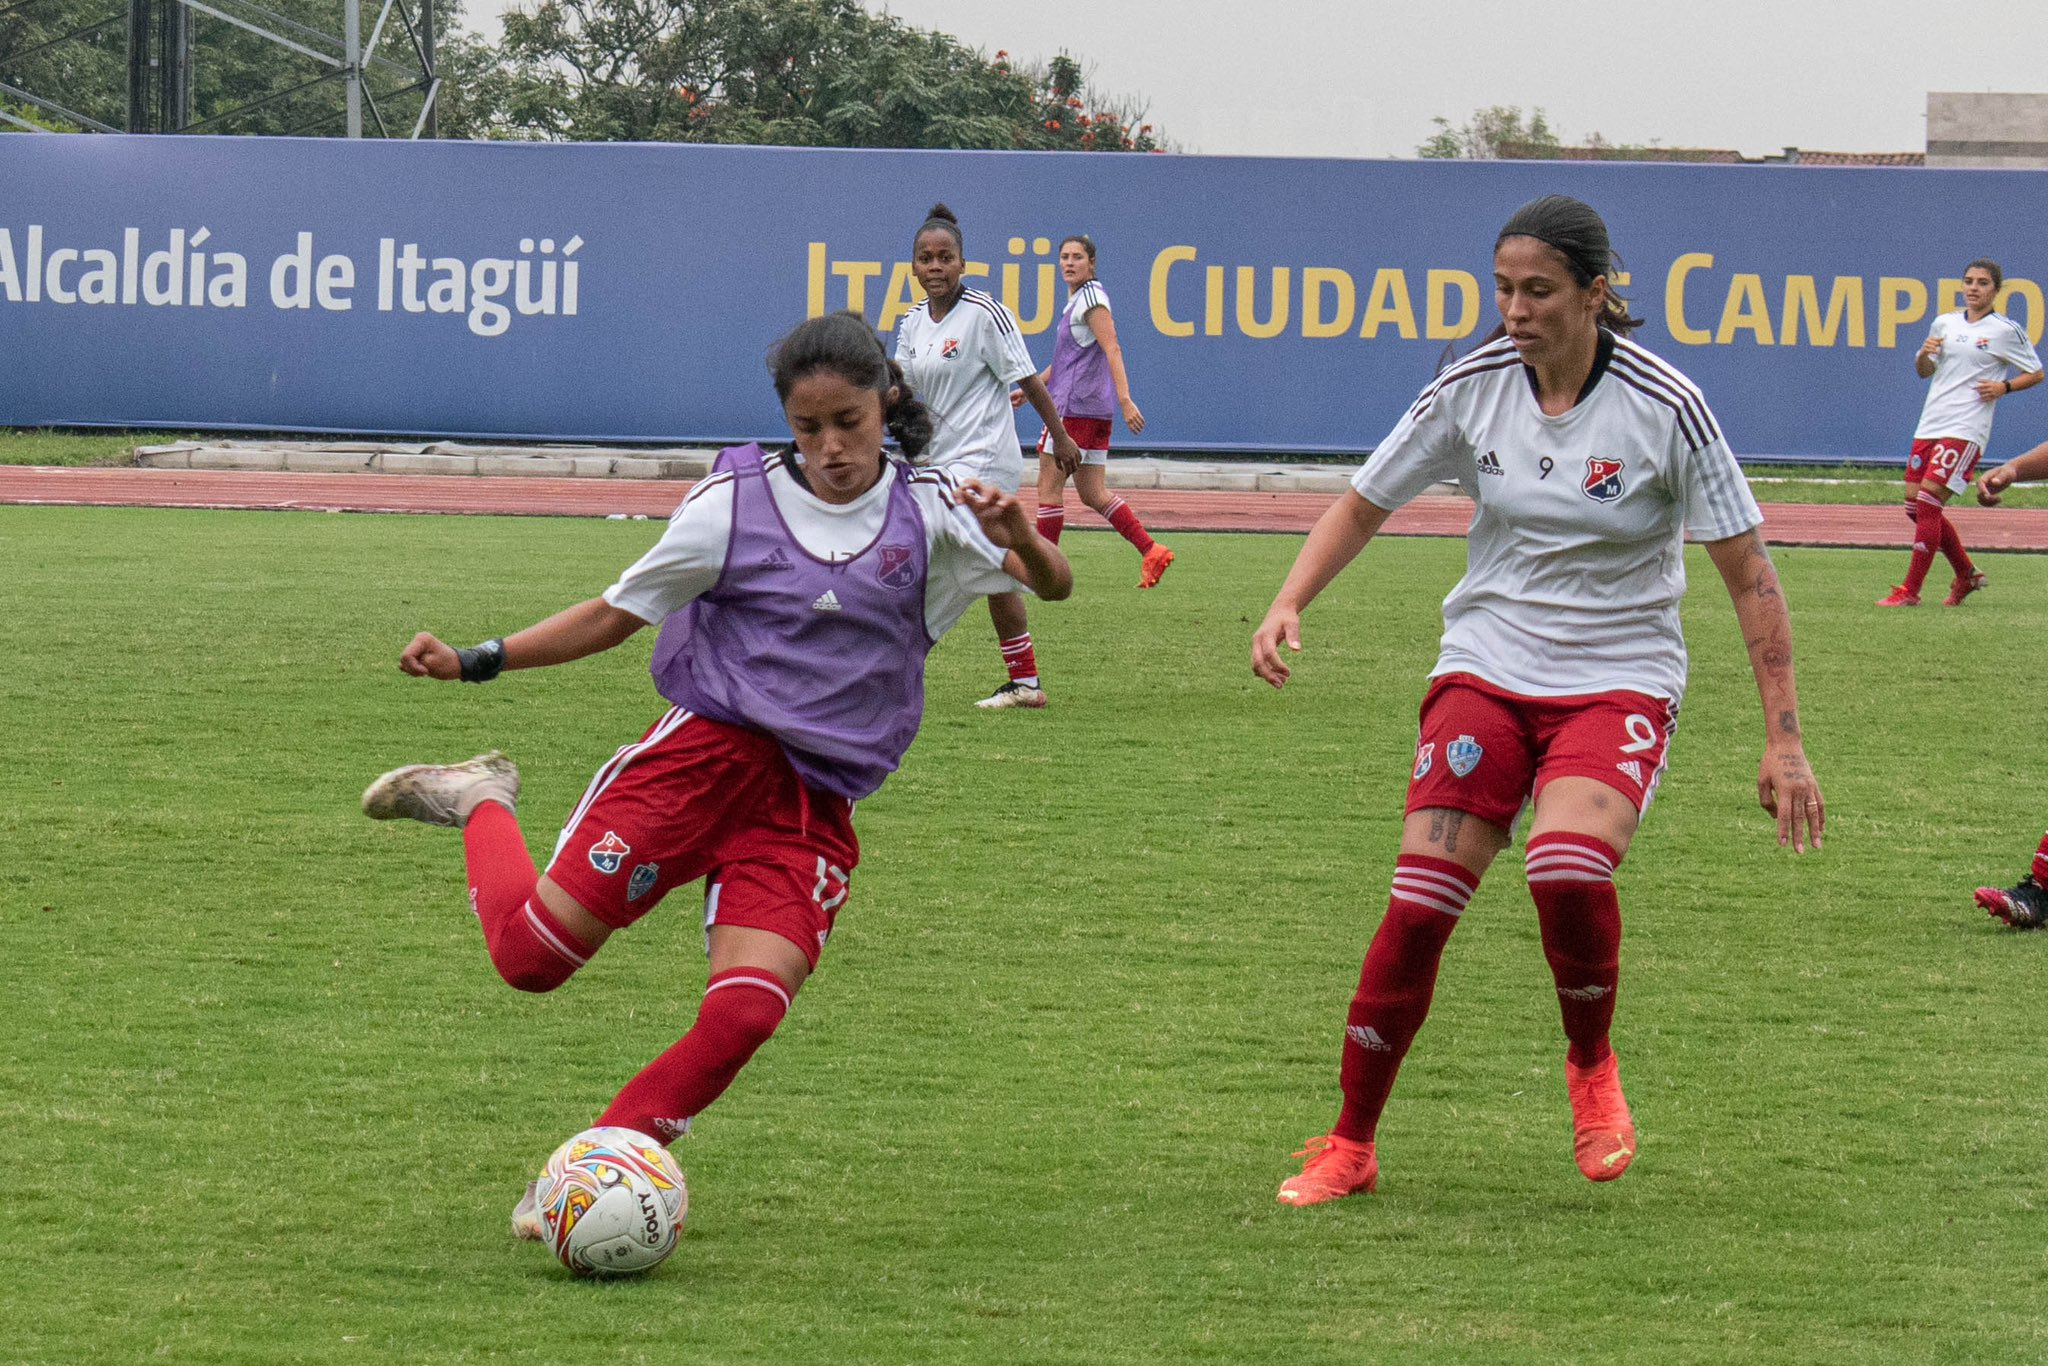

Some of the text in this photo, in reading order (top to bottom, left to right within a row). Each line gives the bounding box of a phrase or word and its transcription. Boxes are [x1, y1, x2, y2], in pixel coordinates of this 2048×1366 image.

[269, 232, 355, 310] de
[378, 234, 585, 336] Itagüí
[1150, 245, 1481, 339] CIUDAD
[1539, 456, 1554, 480] 9
[1930, 443, 1959, 470] 20
[830, 550, 855, 575] 17
[1618, 713, 1657, 754] 9
[812, 855, 849, 912] 17
[637, 1192, 660, 1245] GOLTY
